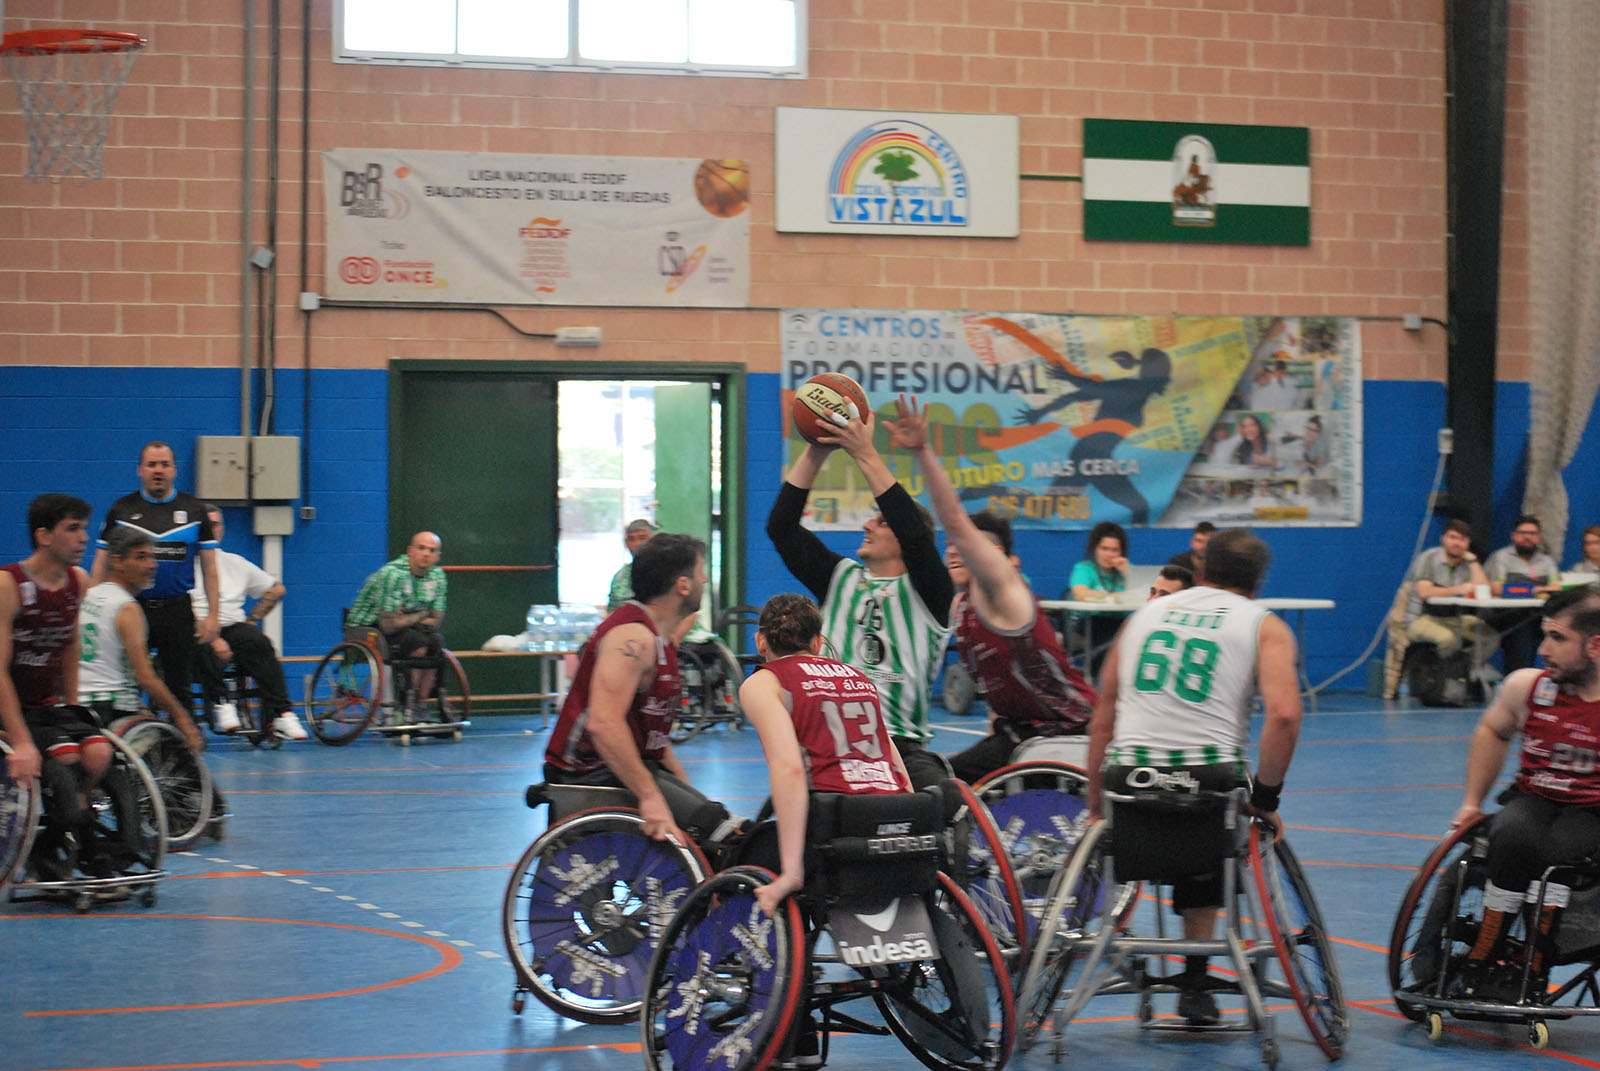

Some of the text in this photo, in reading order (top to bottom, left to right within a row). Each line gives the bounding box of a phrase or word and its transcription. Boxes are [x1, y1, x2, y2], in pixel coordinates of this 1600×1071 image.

[468, 169, 502, 182] LIGA
[506, 170, 578, 185] NACIONAL
[424, 185, 671, 204] BALONCESTO EN SILLA DE RUEDAS
[830, 196, 967, 224] VISTAZUL
[383, 270, 434, 284] ONCE
[818, 315, 942, 339] CENTROS
[789, 359, 1048, 396] PROFESIONAL
[1078, 457, 1142, 477] CERCA
[1135, 630, 1222, 704] 68
[800, 678, 878, 693] araba álava
[820, 699, 885, 760] 13
[838, 935, 934, 965] indesa
